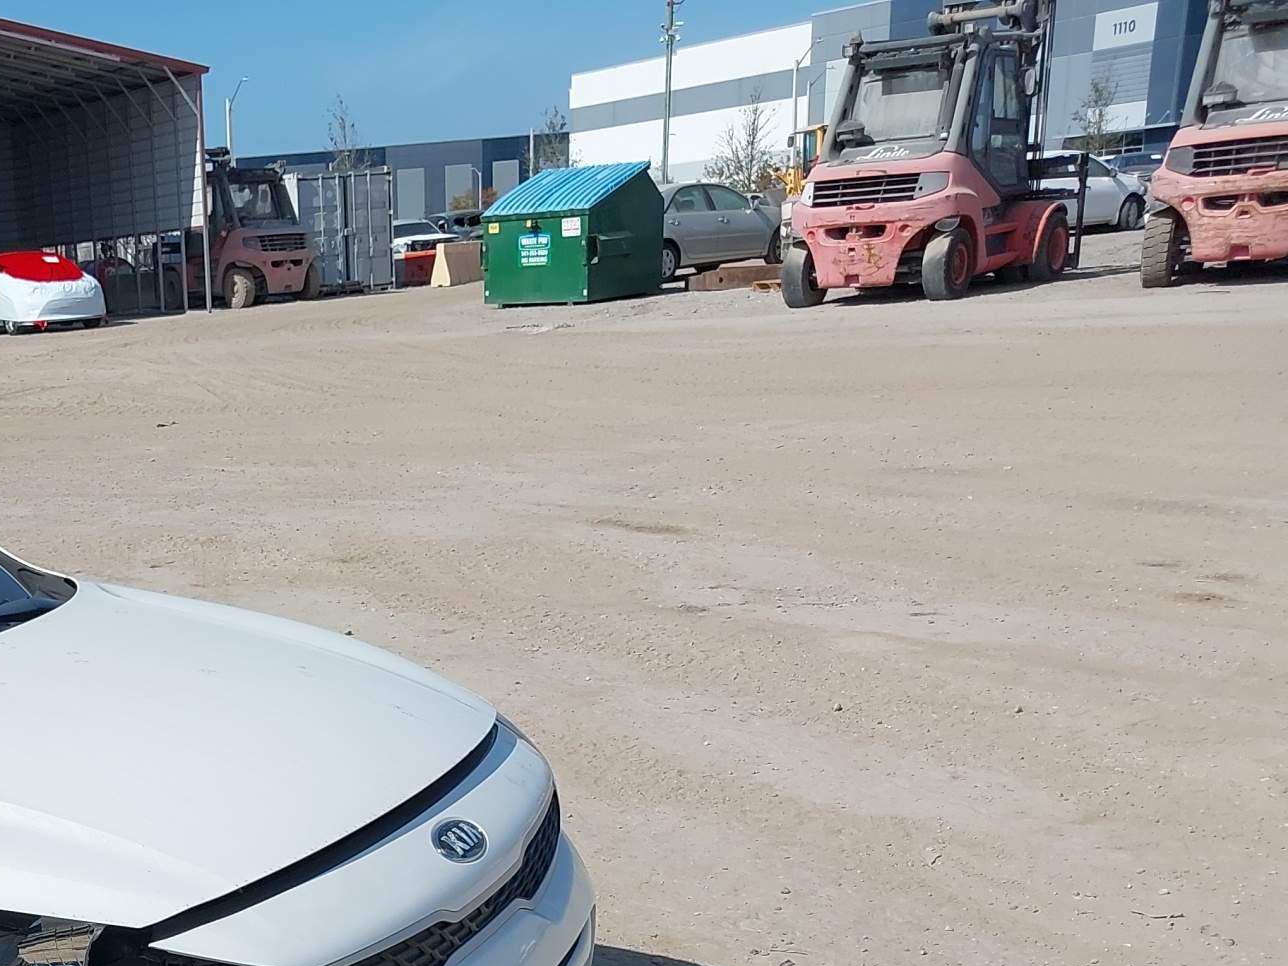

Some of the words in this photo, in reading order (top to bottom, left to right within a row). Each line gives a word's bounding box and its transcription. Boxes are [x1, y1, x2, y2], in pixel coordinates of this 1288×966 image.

[1113, 19, 1136, 36] 1110
[855, 144, 910, 161] Linde
[440, 822, 483, 856] KIA
